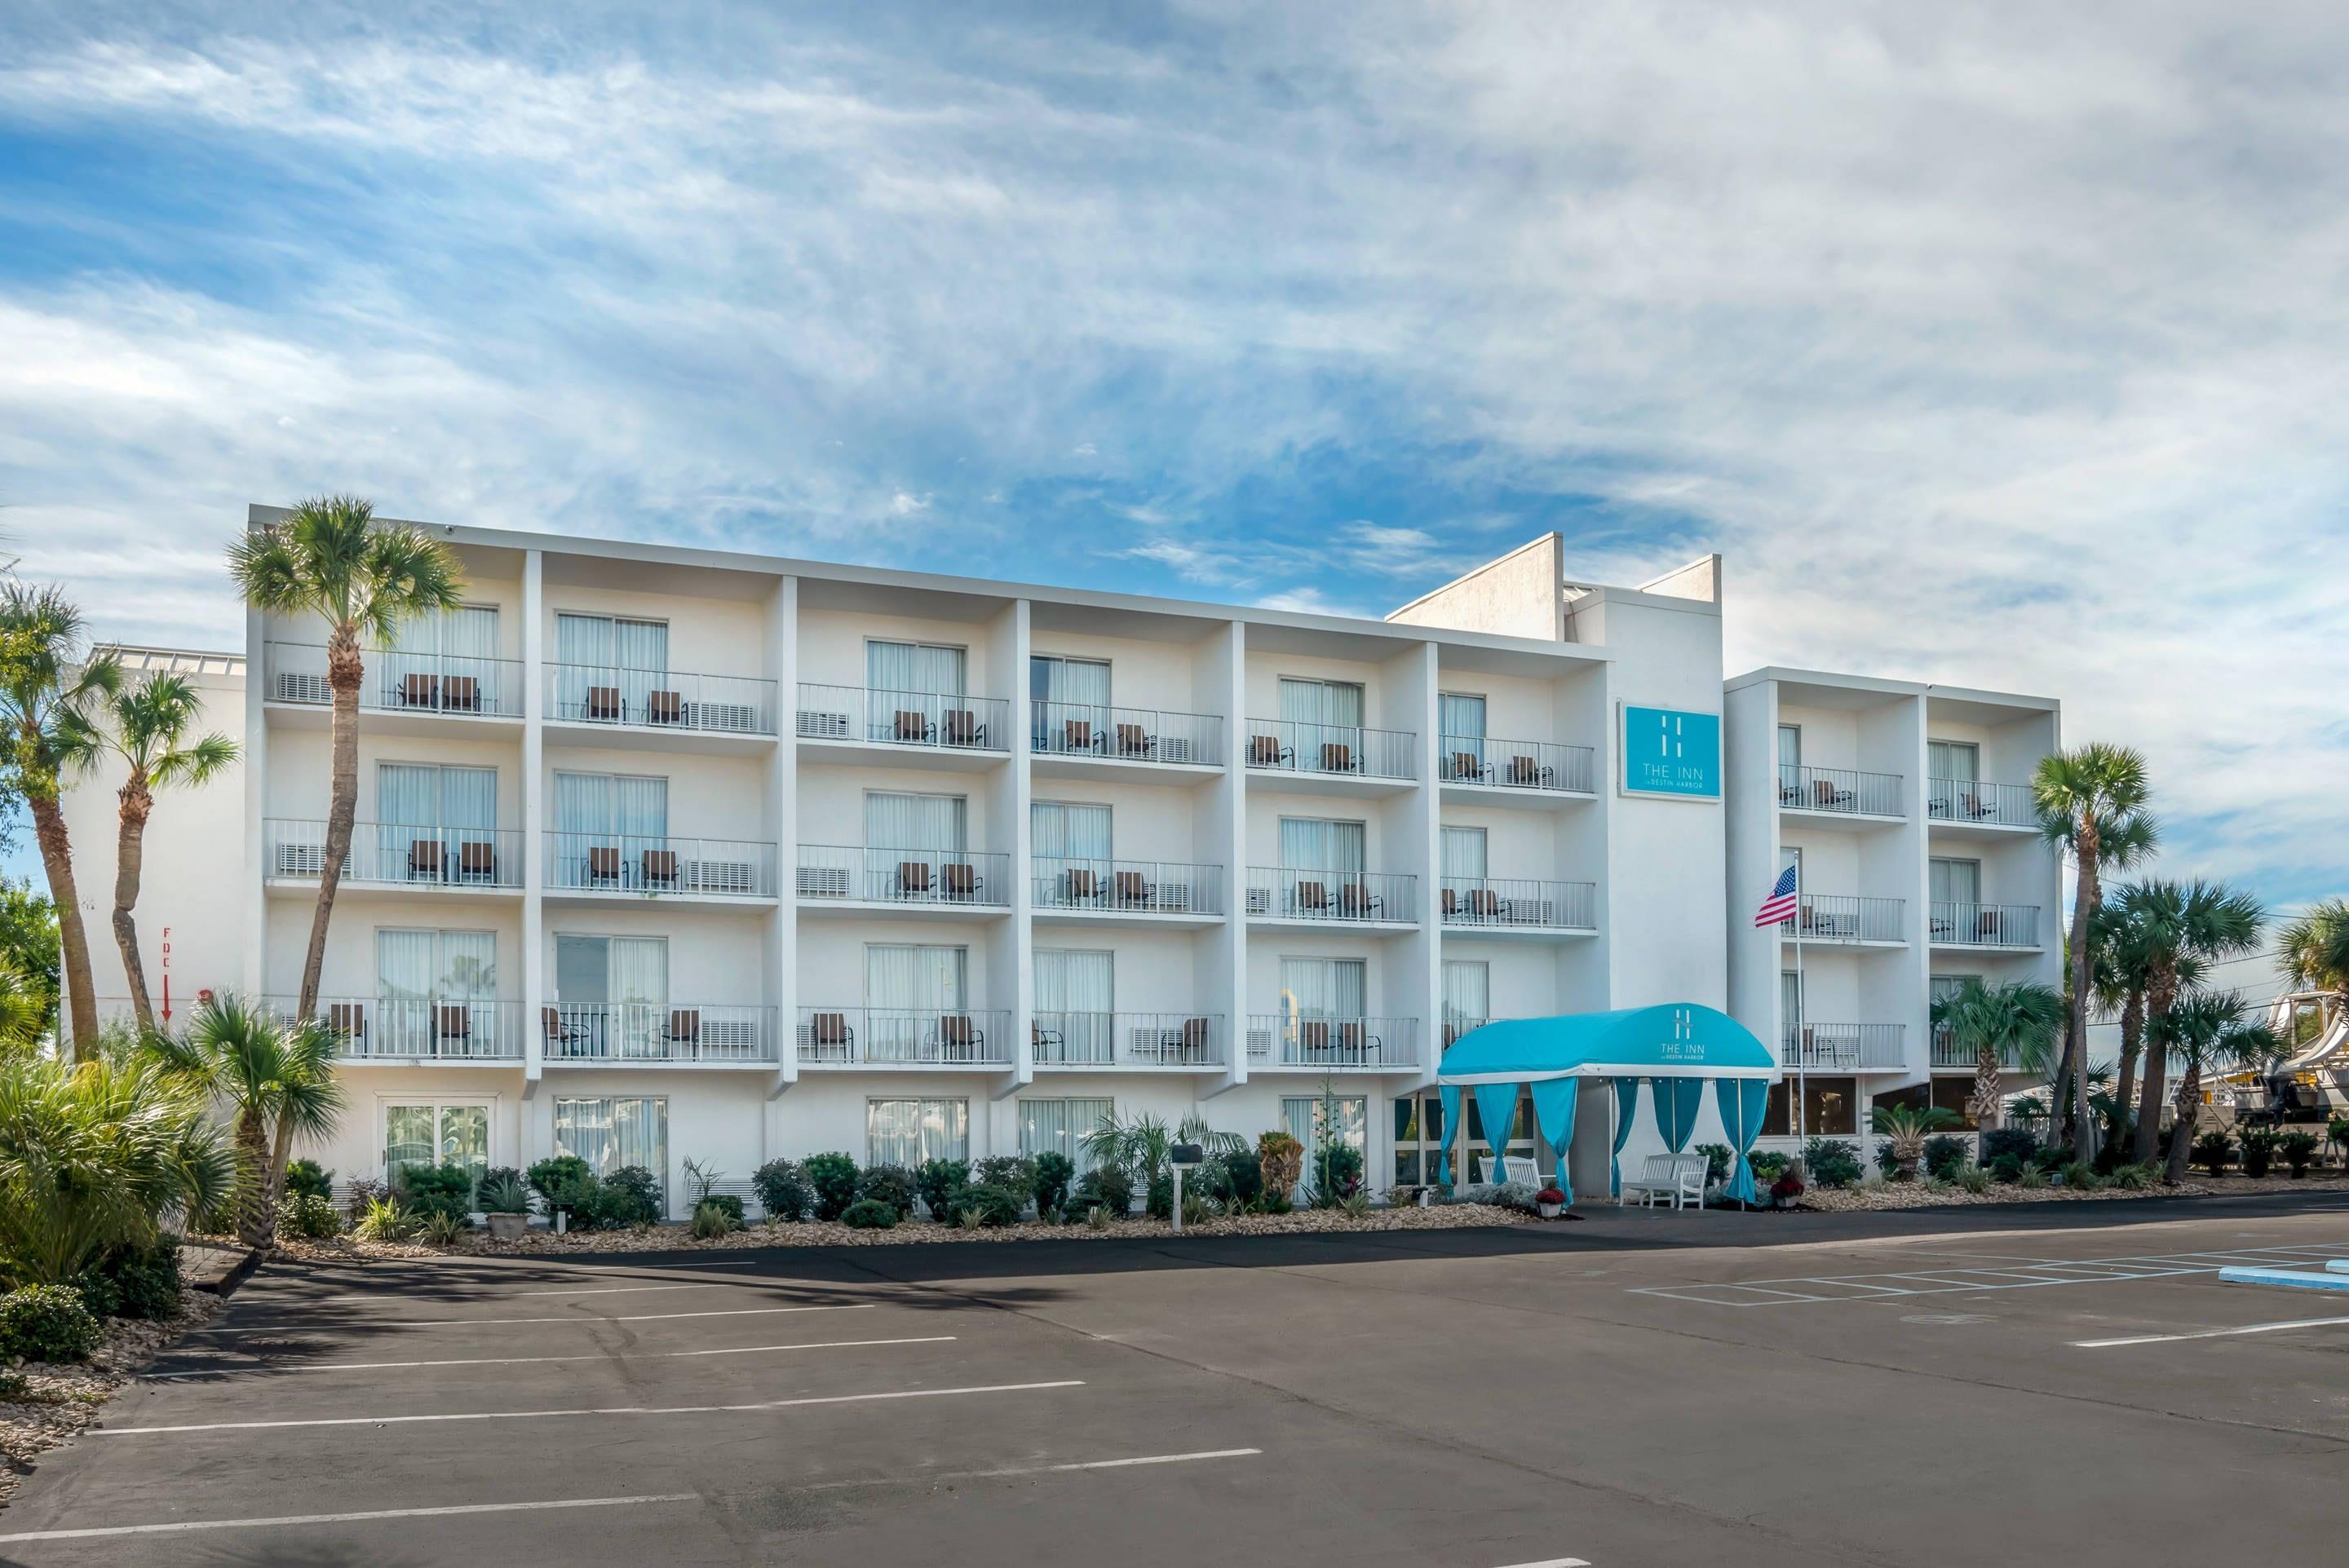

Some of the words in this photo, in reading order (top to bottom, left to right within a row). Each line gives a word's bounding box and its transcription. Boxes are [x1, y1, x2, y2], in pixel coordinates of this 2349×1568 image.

[1643, 762, 1670, 778] THE
[1678, 766, 1703, 780] INN
[1651, 779, 1674, 787] DESTIN
[1676, 781, 1703, 789] HARBOR
[1661, 1044, 1680, 1053] THE
[1685, 1044, 1705, 1054] INN
